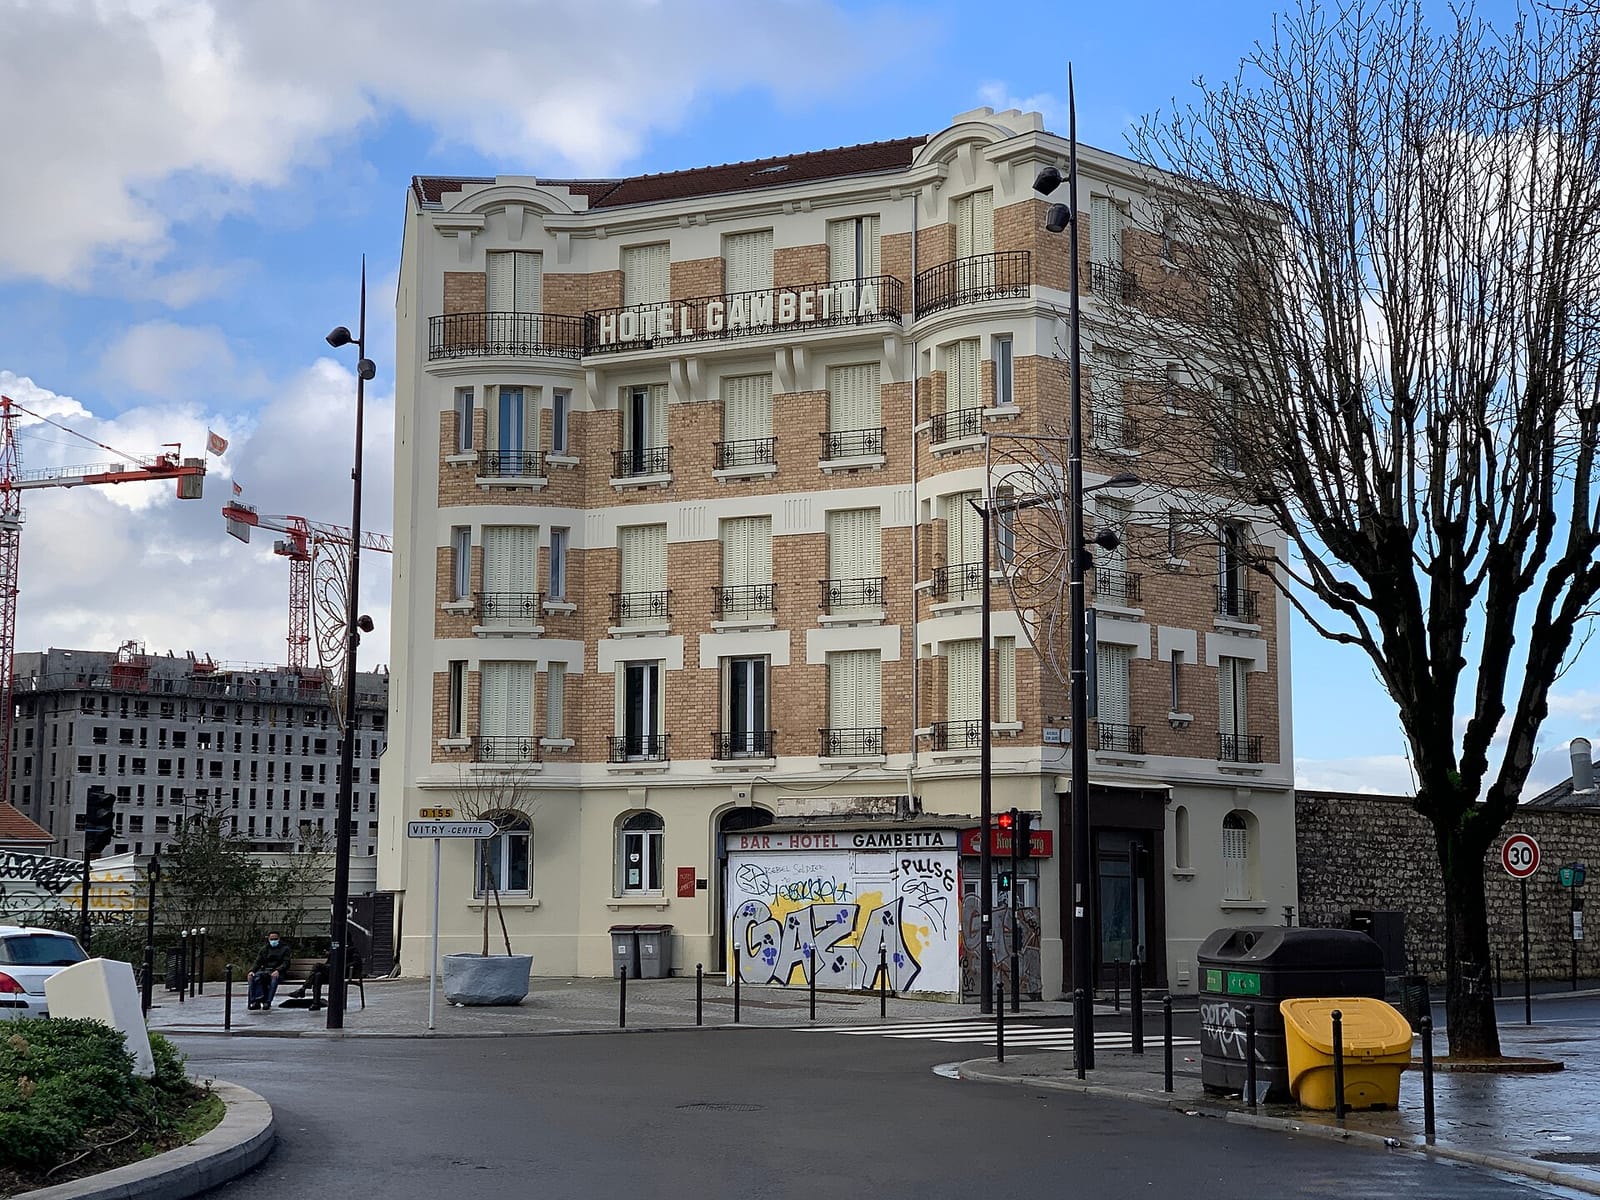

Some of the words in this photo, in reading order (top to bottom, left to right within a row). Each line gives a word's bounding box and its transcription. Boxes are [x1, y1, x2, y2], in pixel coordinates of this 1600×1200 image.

[600, 306, 694, 345] HOTEL
[706, 285, 878, 332] GAMBETTA
[421, 809, 428, 817] D
[431, 809, 451, 817] 155
[412, 825, 445, 834] VITRY
[740, 834, 770, 849] BAR
[789, 834, 839, 849] HOTEL
[853, 832, 944, 848] GAMBETTA
[1510, 847, 1532, 865] 30
